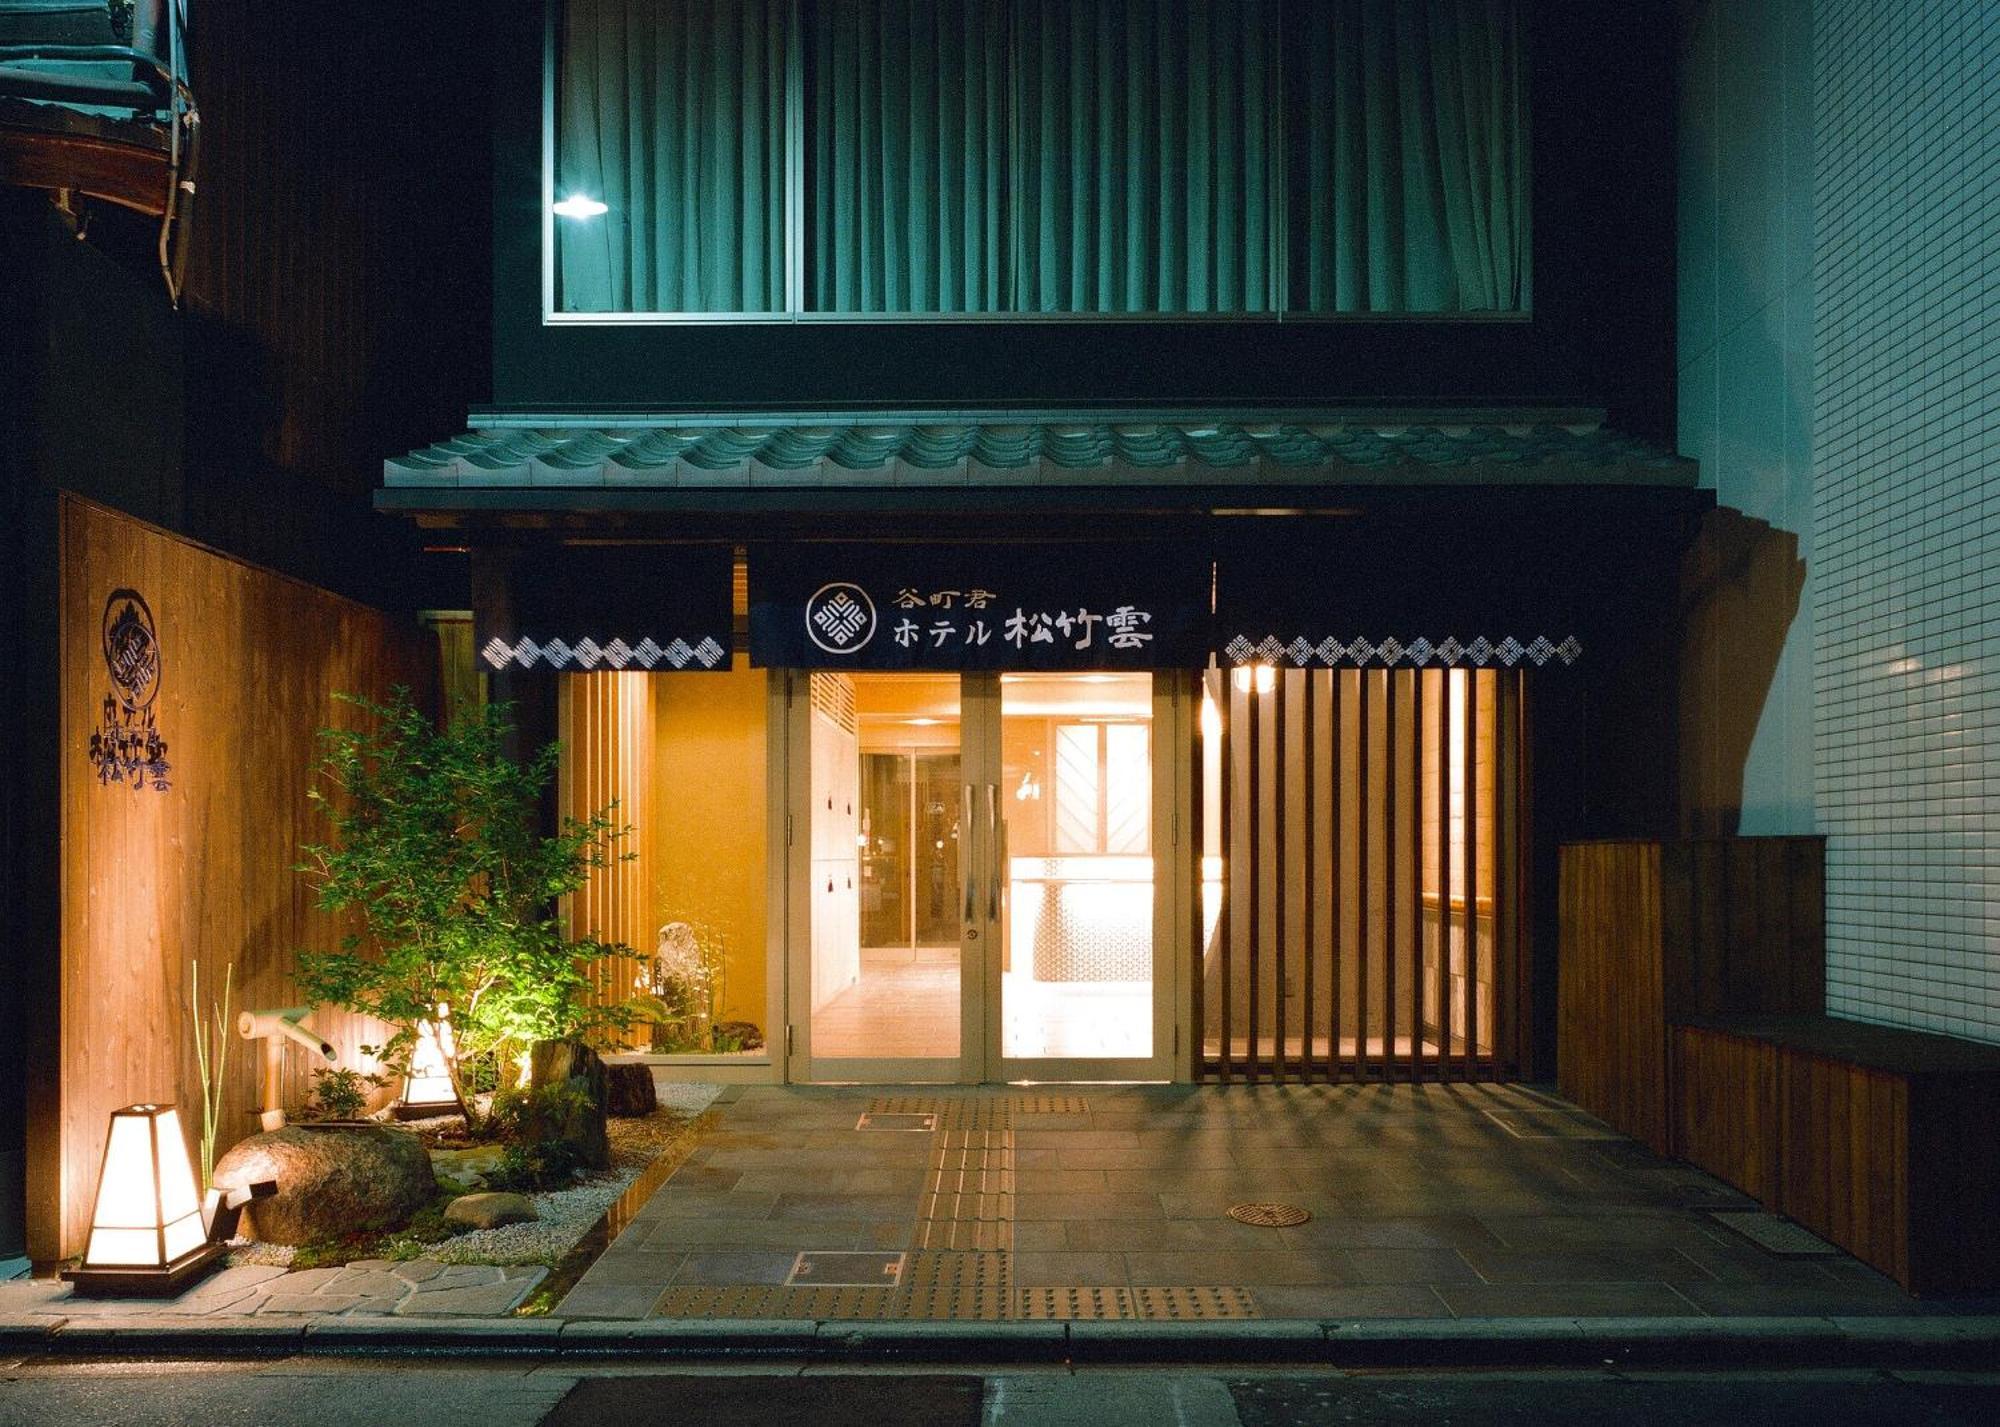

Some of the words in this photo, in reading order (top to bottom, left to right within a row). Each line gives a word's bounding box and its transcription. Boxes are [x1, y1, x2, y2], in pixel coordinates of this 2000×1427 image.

[892, 588, 997, 609] 谷町君
[893, 617, 992, 648] ホテル
[1003, 605, 1154, 650] 松竹雲
